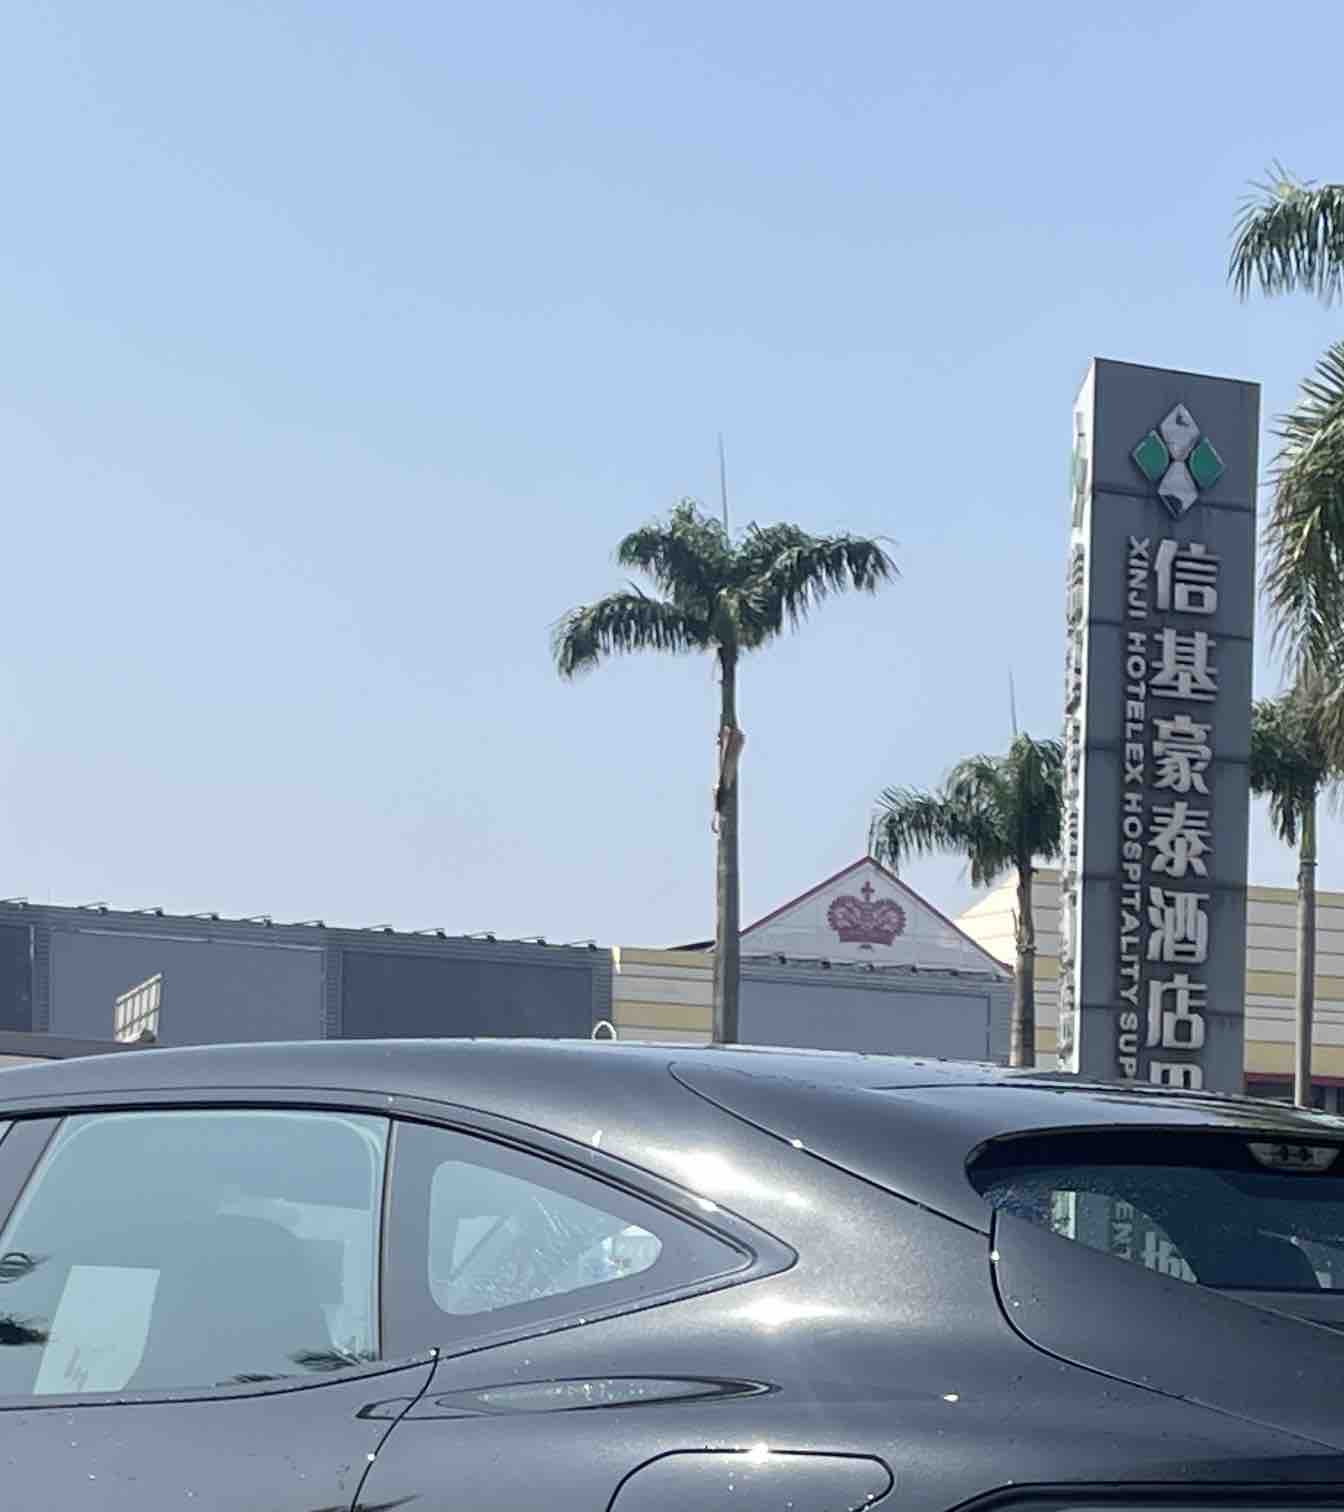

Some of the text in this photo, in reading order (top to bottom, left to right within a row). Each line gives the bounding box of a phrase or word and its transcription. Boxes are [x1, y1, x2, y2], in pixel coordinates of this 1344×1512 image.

[1127, 535, 1150, 620] XINJI
[1124, 632, 1147, 784] HOTELEX
[1120, 793, 1144, 1006] HOSPITALITY
